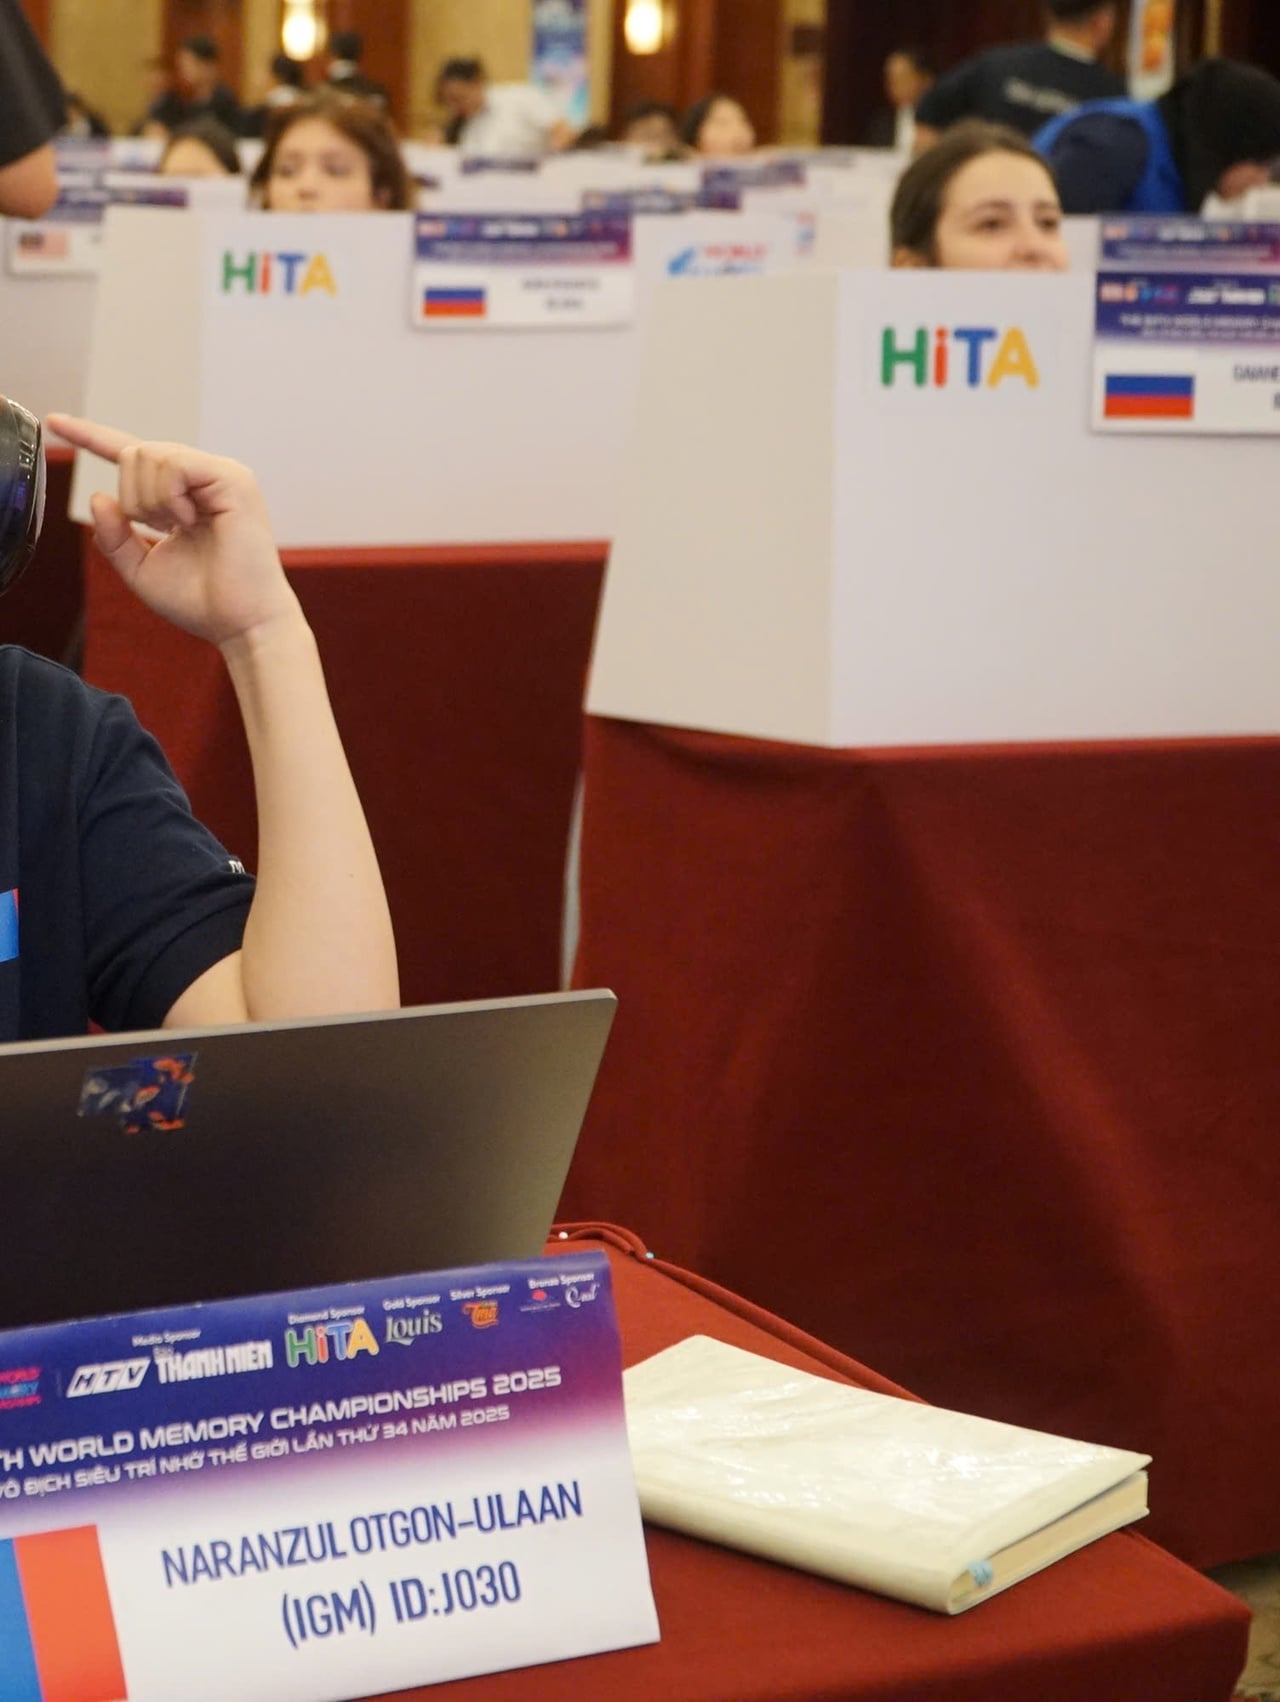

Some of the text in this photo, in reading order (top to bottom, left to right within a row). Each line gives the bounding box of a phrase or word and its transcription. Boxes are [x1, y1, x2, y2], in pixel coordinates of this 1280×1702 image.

[880, 326, 1040, 389] HiTA
[284, 1316, 380, 1369] HiTA
[385, 1309, 444, 1346] Louis
[66, 1356, 151, 1399] HTV
[28, 1432, 135, 1468] WORLD
[139, 1412, 265, 1451] MEMORY
[270, 1377, 488, 1430] CHAMPIONSHIPS
[492, 1366, 562, 1396] 2025
[74, 1463, 121, 1489] SIÊU
[124, 1455, 156, 1480] TRÍ
[383, 1421, 408, 1440] 34
[411, 1411, 457, 1436] NĂM
[460, 1404, 510, 1427] 2025
[160, 1480, 584, 1588] NARANZUL OTGON-ULAAN
[281, 1560, 523, 1648] (IGM) ID:J030
